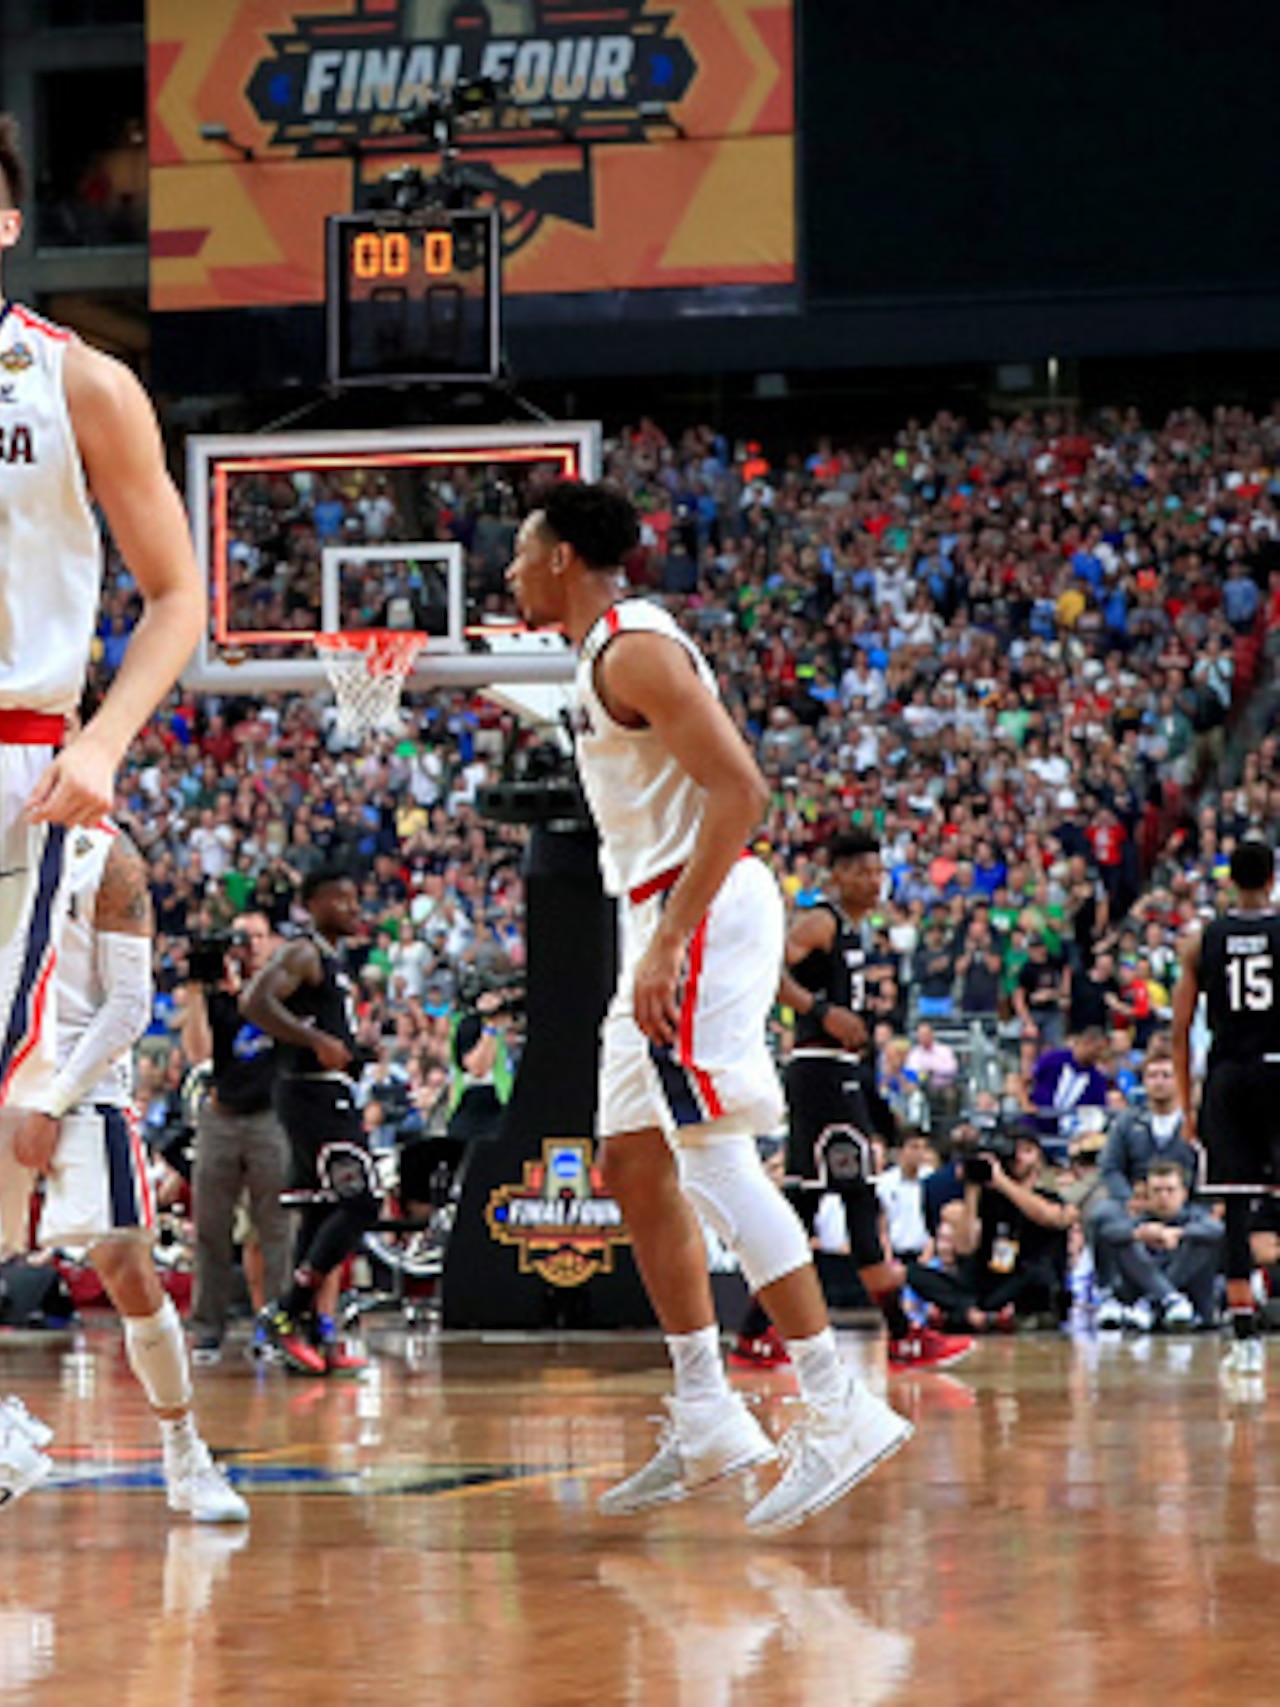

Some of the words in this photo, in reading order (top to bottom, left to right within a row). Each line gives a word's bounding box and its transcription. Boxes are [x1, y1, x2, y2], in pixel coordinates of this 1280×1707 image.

[302, 45, 463, 114] FINAL
[480, 35, 635, 104] FOUR
[1225, 955, 1274, 1011] 15
[508, 1199, 565, 1225] FINAL
